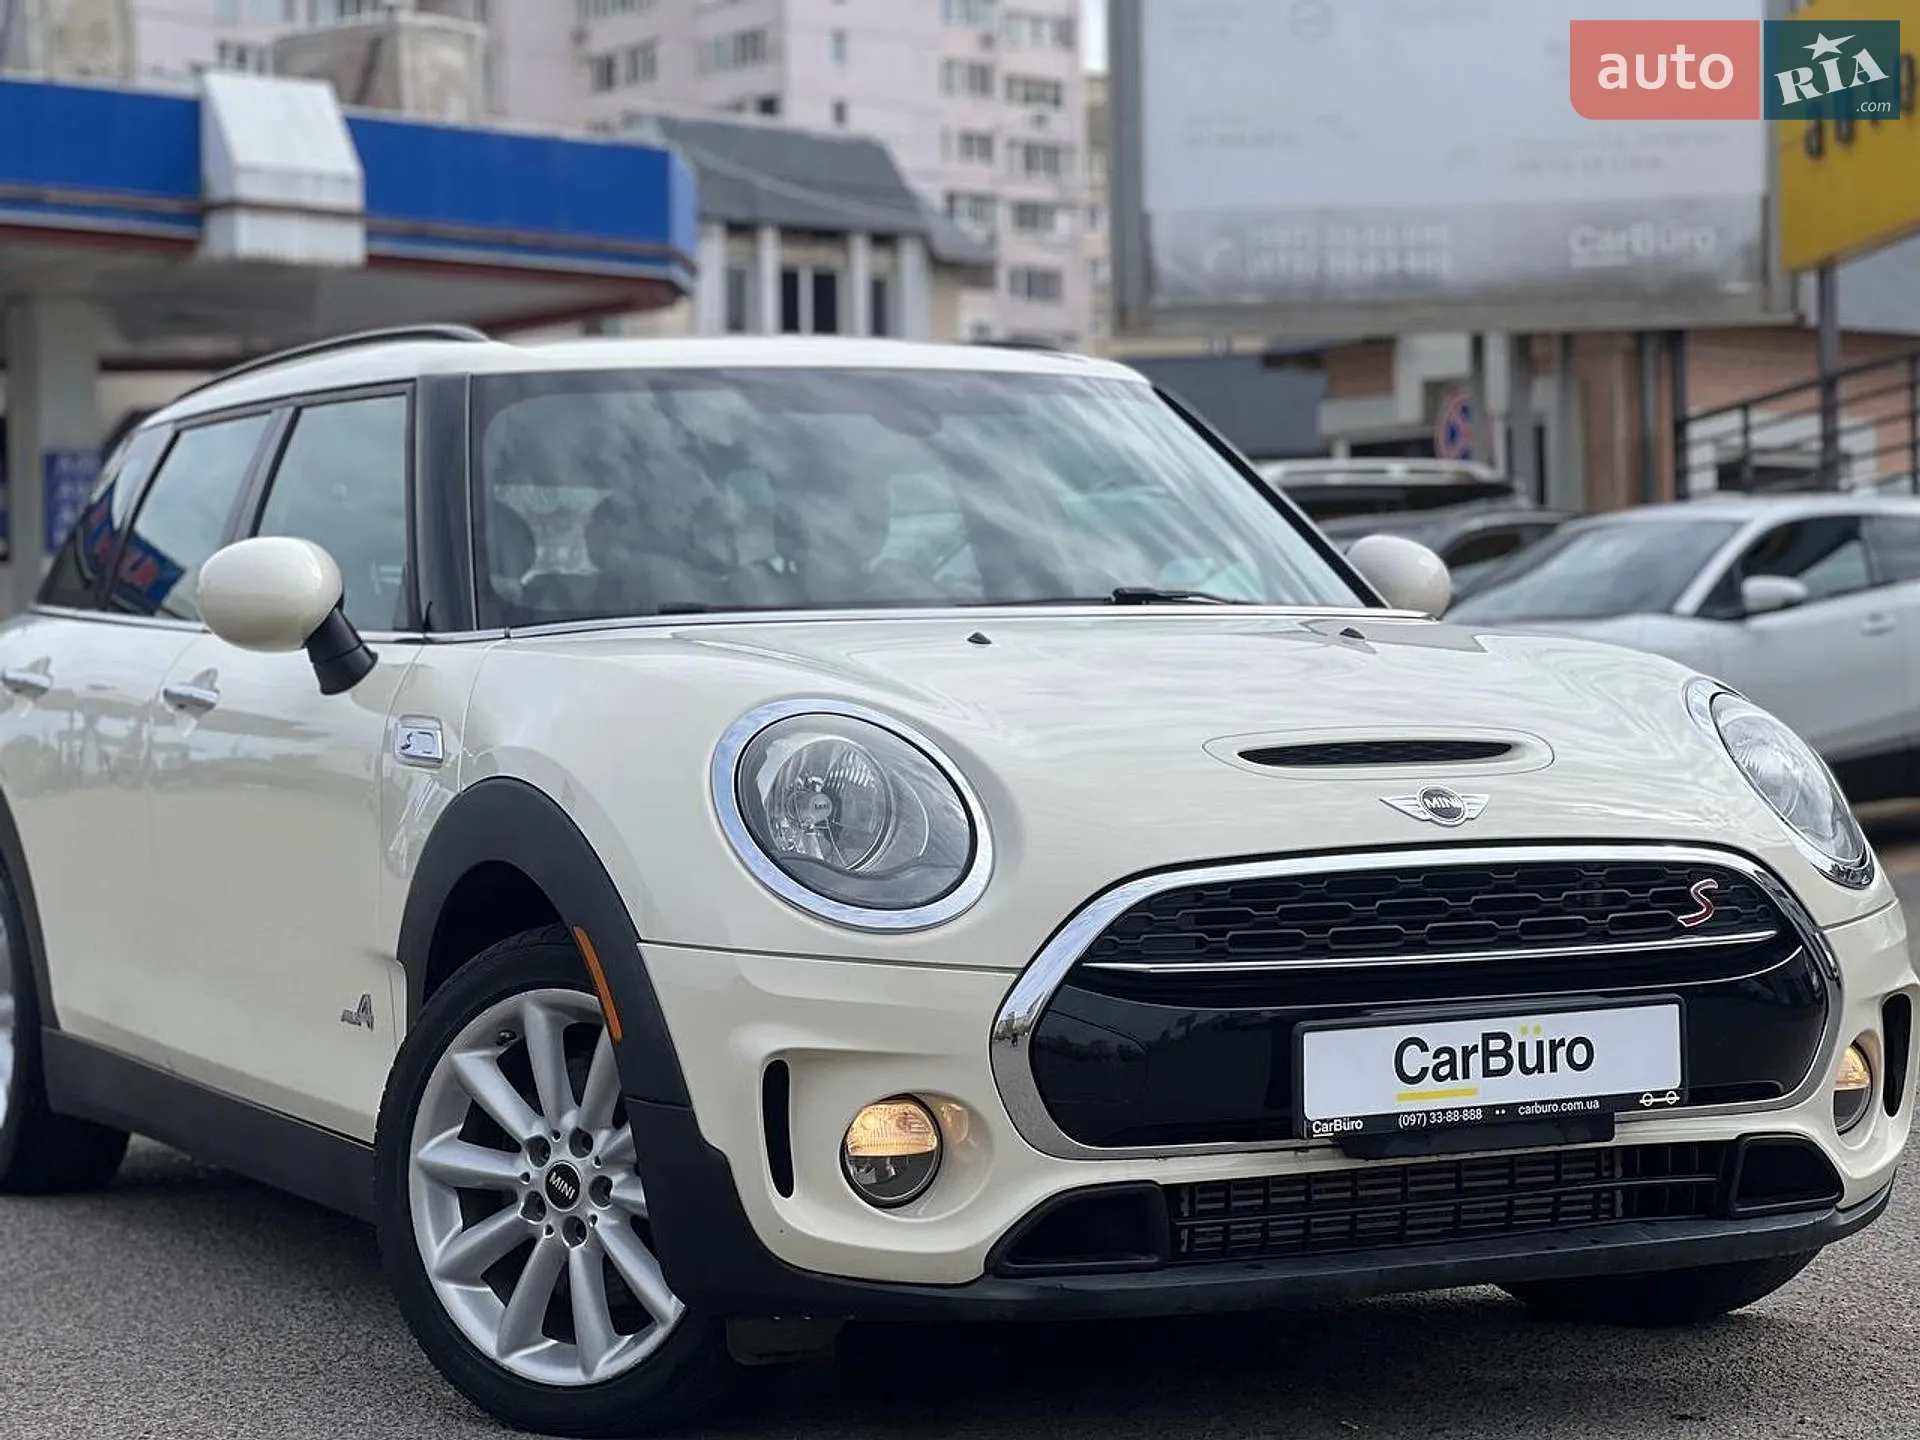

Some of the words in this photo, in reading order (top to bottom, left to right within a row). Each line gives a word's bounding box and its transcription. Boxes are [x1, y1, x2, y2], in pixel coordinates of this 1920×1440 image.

[1423, 796, 1462, 809] MINI
[1677, 878, 1719, 927] S
[1393, 1024, 1595, 1086] CarBüro
[1312, 1117, 1364, 1133] CarBüro
[1398, 1111, 1427, 1129] (097)
[1429, 1108, 1483, 1123] 33-88-888
[1518, 1099, 1600, 1116] carburo.com.ua
[549, 1171, 576, 1200] MINI
